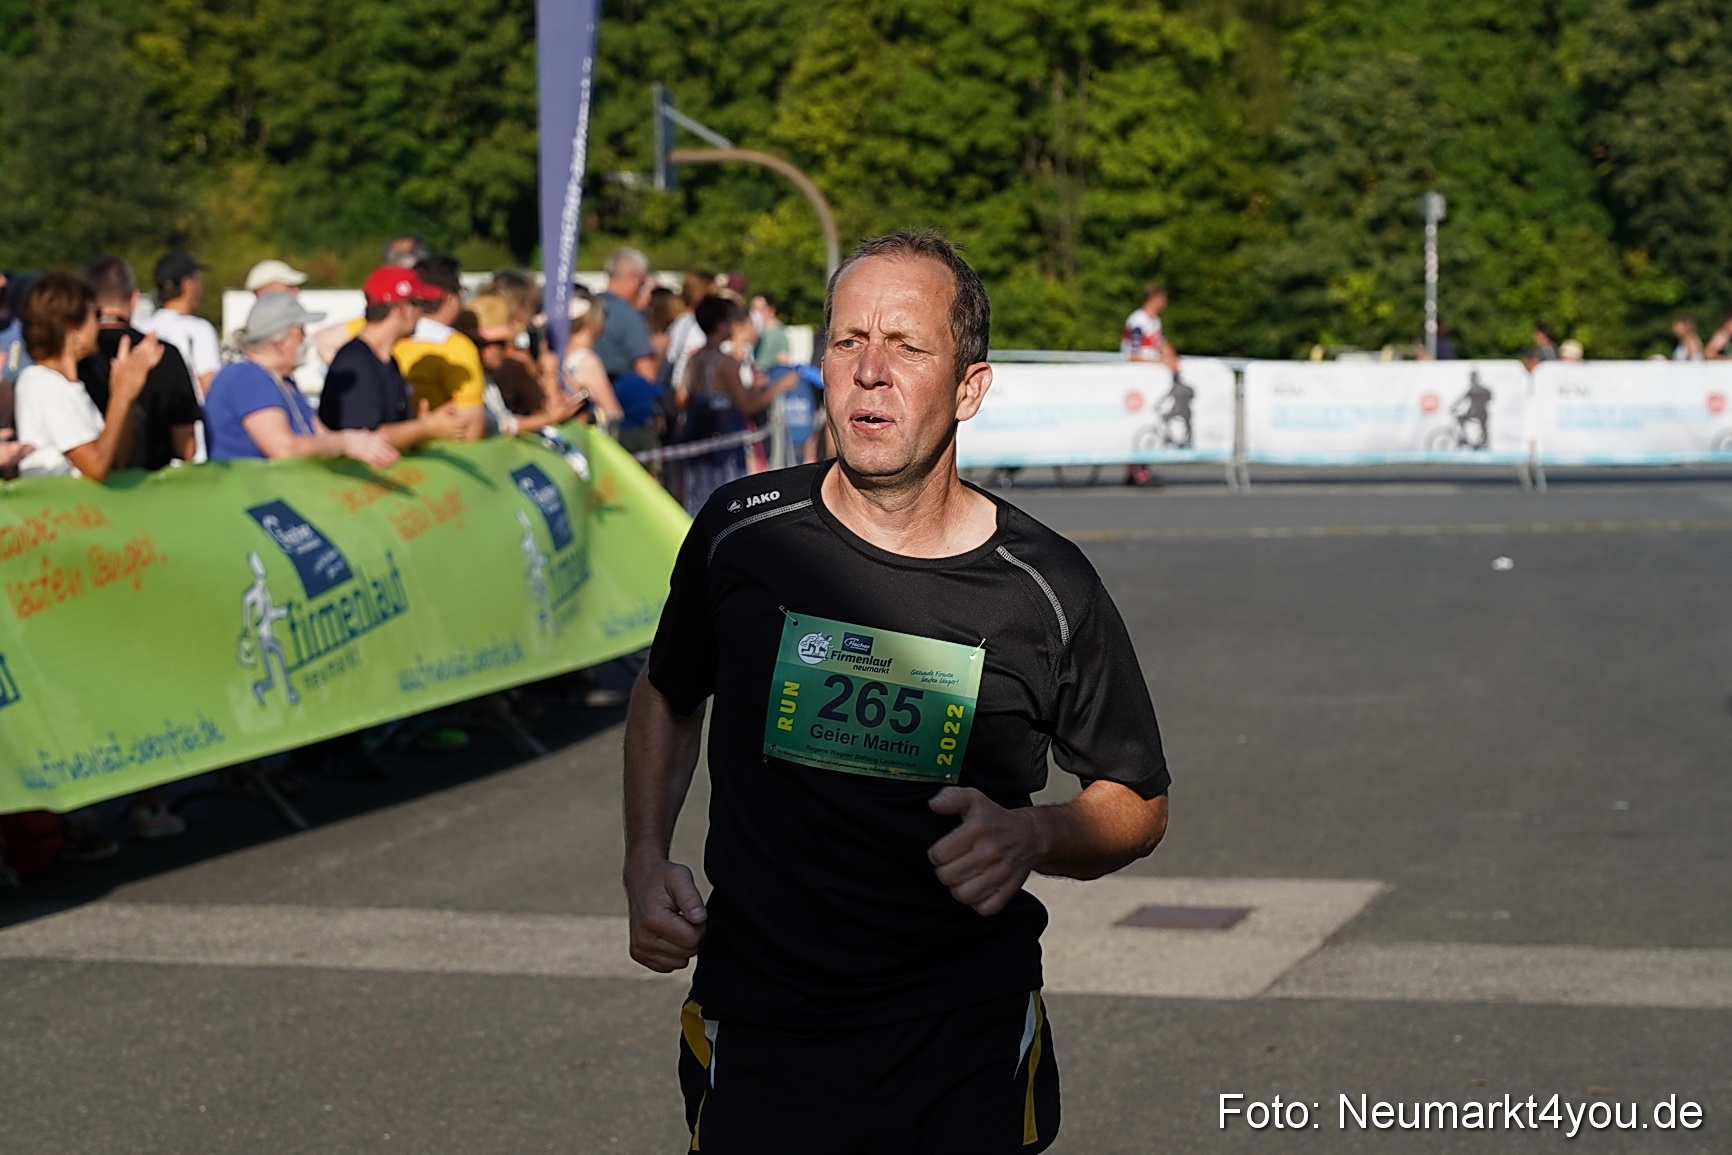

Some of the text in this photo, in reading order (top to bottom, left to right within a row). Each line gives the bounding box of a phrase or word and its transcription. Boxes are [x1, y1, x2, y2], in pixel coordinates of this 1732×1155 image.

[746, 491, 780, 508] JAKO
[287, 550, 408, 668] firmenlauf
[831, 650, 893, 668] Firmenlauf
[853, 664, 890, 674] neumarkt
[777, 681, 800, 731] RUN
[817, 674, 924, 734] 265
[810, 723, 920, 756] Geier Martin
[936, 704, 965, 766] 2022
[805, 744, 829, 756] Regens
[830, 748, 852, 759] Wagner
[855, 753, 878, 763] Stiftung
